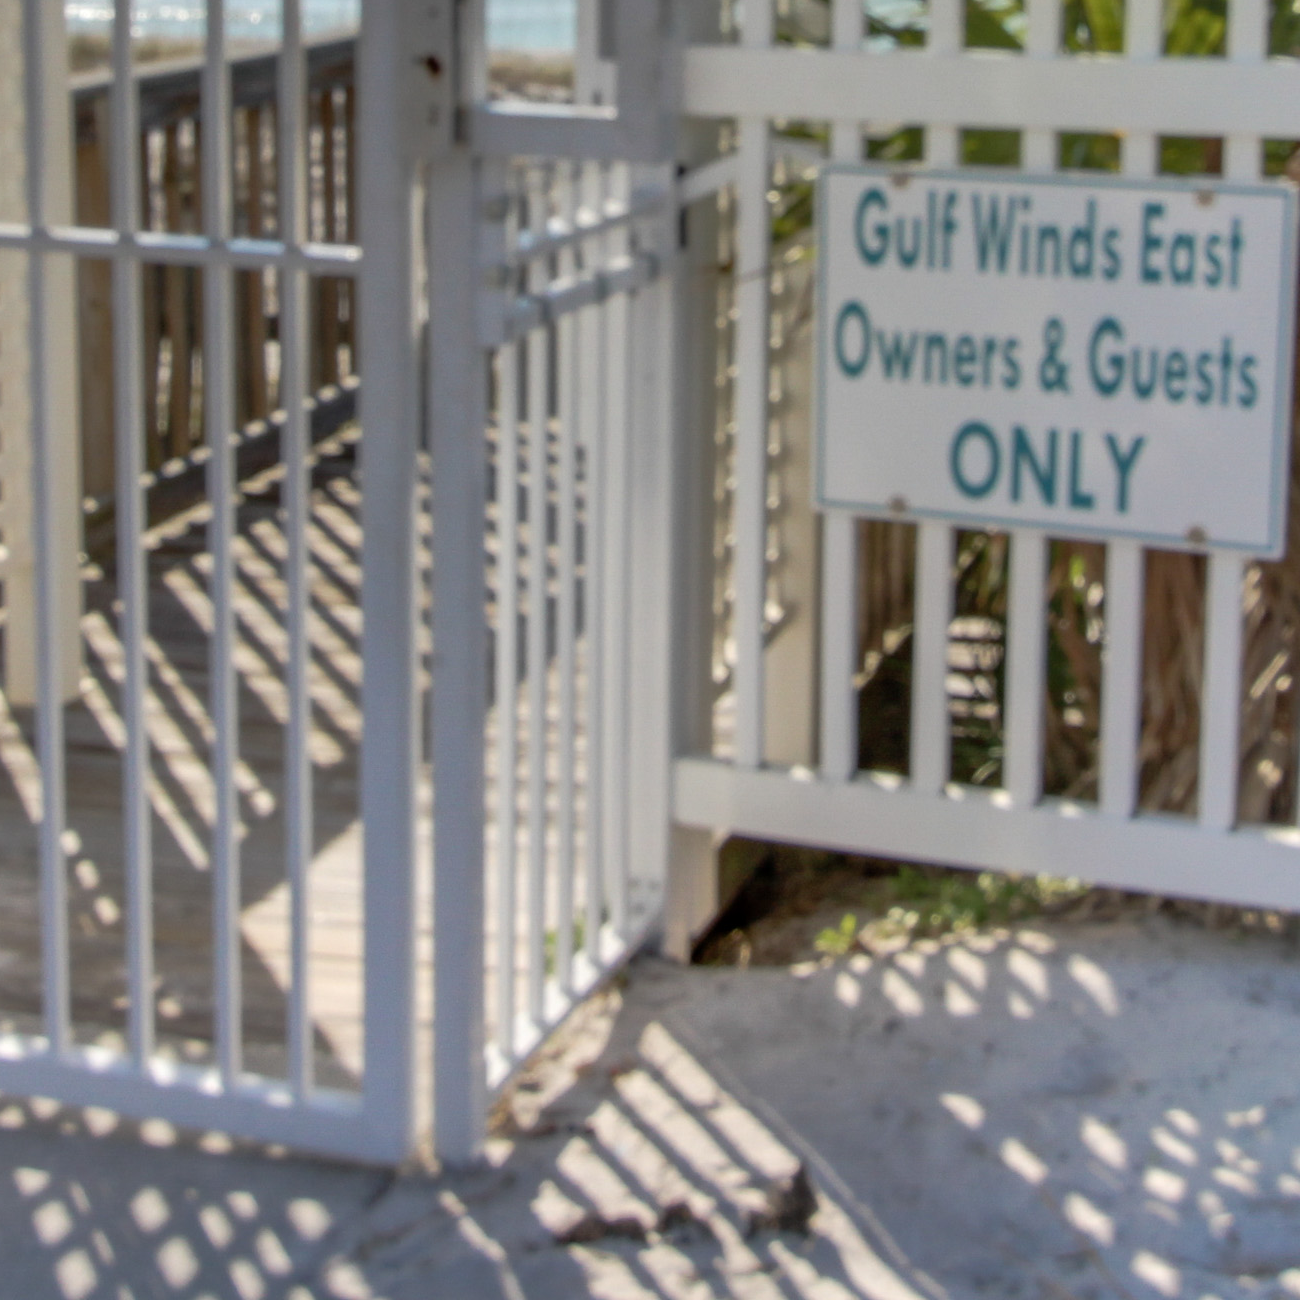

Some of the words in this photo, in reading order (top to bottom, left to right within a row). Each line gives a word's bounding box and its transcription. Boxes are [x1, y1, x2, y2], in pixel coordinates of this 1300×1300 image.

[853, 187, 958, 271] Gulf
[972, 193, 1121, 281] Winds
[1140, 202, 1242, 289] East
[835, 300, 1021, 390] Owners
[1039, 316, 1071, 395] &
[1088, 317, 1258, 409] Guests
[950, 421, 1145, 514] ONLY
